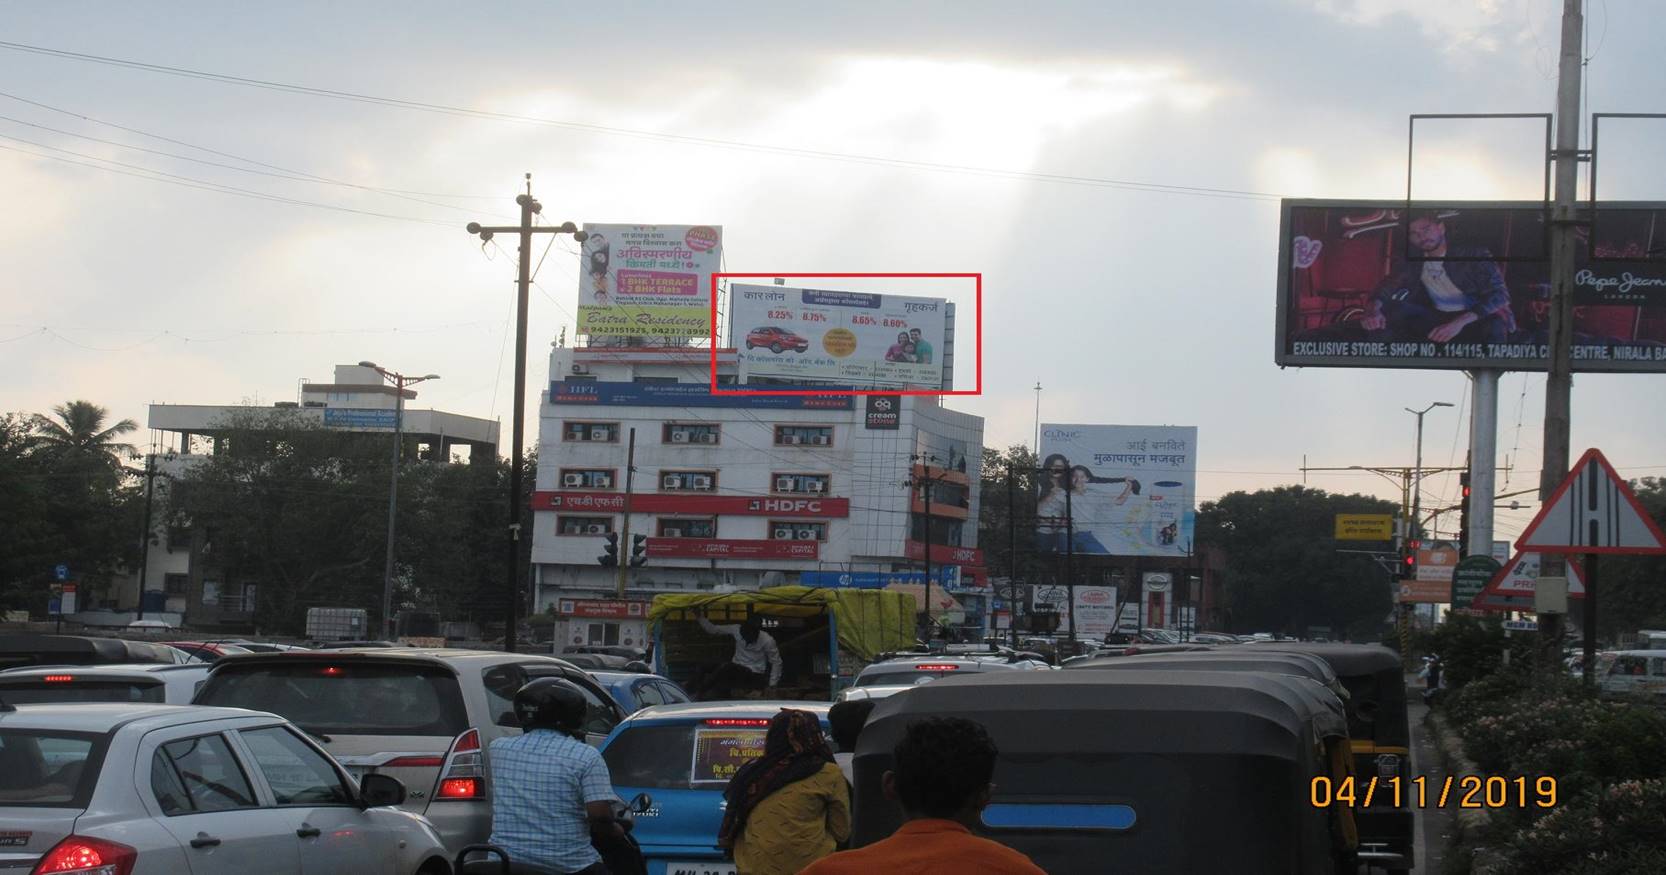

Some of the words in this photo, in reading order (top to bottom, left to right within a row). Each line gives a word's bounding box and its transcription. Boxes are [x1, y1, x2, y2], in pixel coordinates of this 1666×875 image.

[651, 279, 693, 287] TERRACE
[1575, 269, 1619, 291] Pepe
[587, 312, 628, 325] Batra
[636, 312, 706, 328] Residency
[1293, 342, 1349, 356] EXCLUSIVE
[1351, 342, 1388, 356] STORE:
[1390, 343, 1417, 357] SHOP
[1487, 344, 1537, 359] TAPADIYA
[1613, 346, 1652, 361] NIRALA
[1043, 430, 1081, 439] CLINIC
[1094, 452, 1146, 466] मुळापासून
[1150, 453, 1186, 467] मजबूत
[765, 499, 822, 513] HDFC
[956, 549, 976, 562] HDFC
